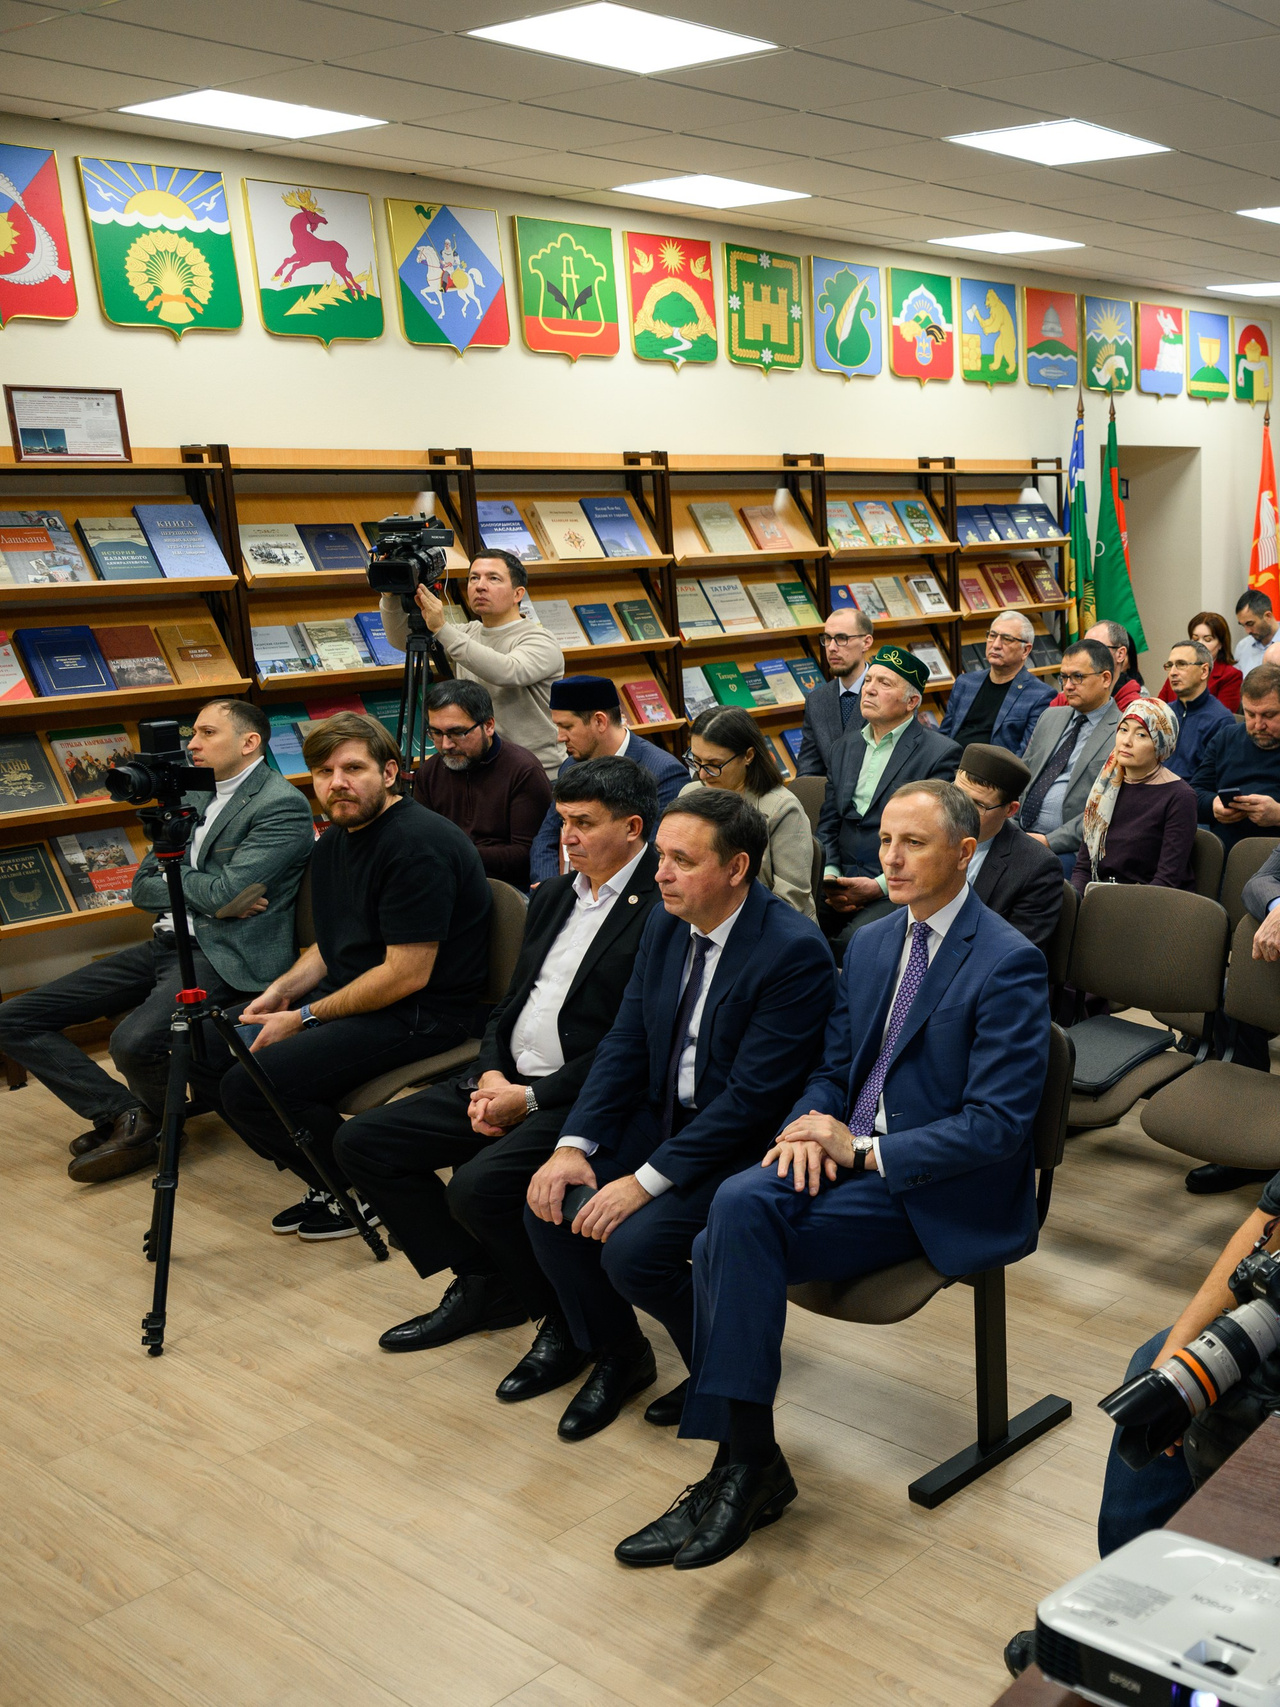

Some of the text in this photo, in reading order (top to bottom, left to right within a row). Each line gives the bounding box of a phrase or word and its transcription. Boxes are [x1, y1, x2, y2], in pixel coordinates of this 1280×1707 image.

[156, 520, 194, 528] КНИГА
[0, 535, 47, 544] Лашманы
[710, 584, 738, 593] ТАТАРЫ
[716, 672, 738, 680] Татары
[0, 861, 35, 873] ТАТАР
[1191, 1592, 1235, 1614] EPSON
[1108, 1671, 1142, 1695] EPSON
